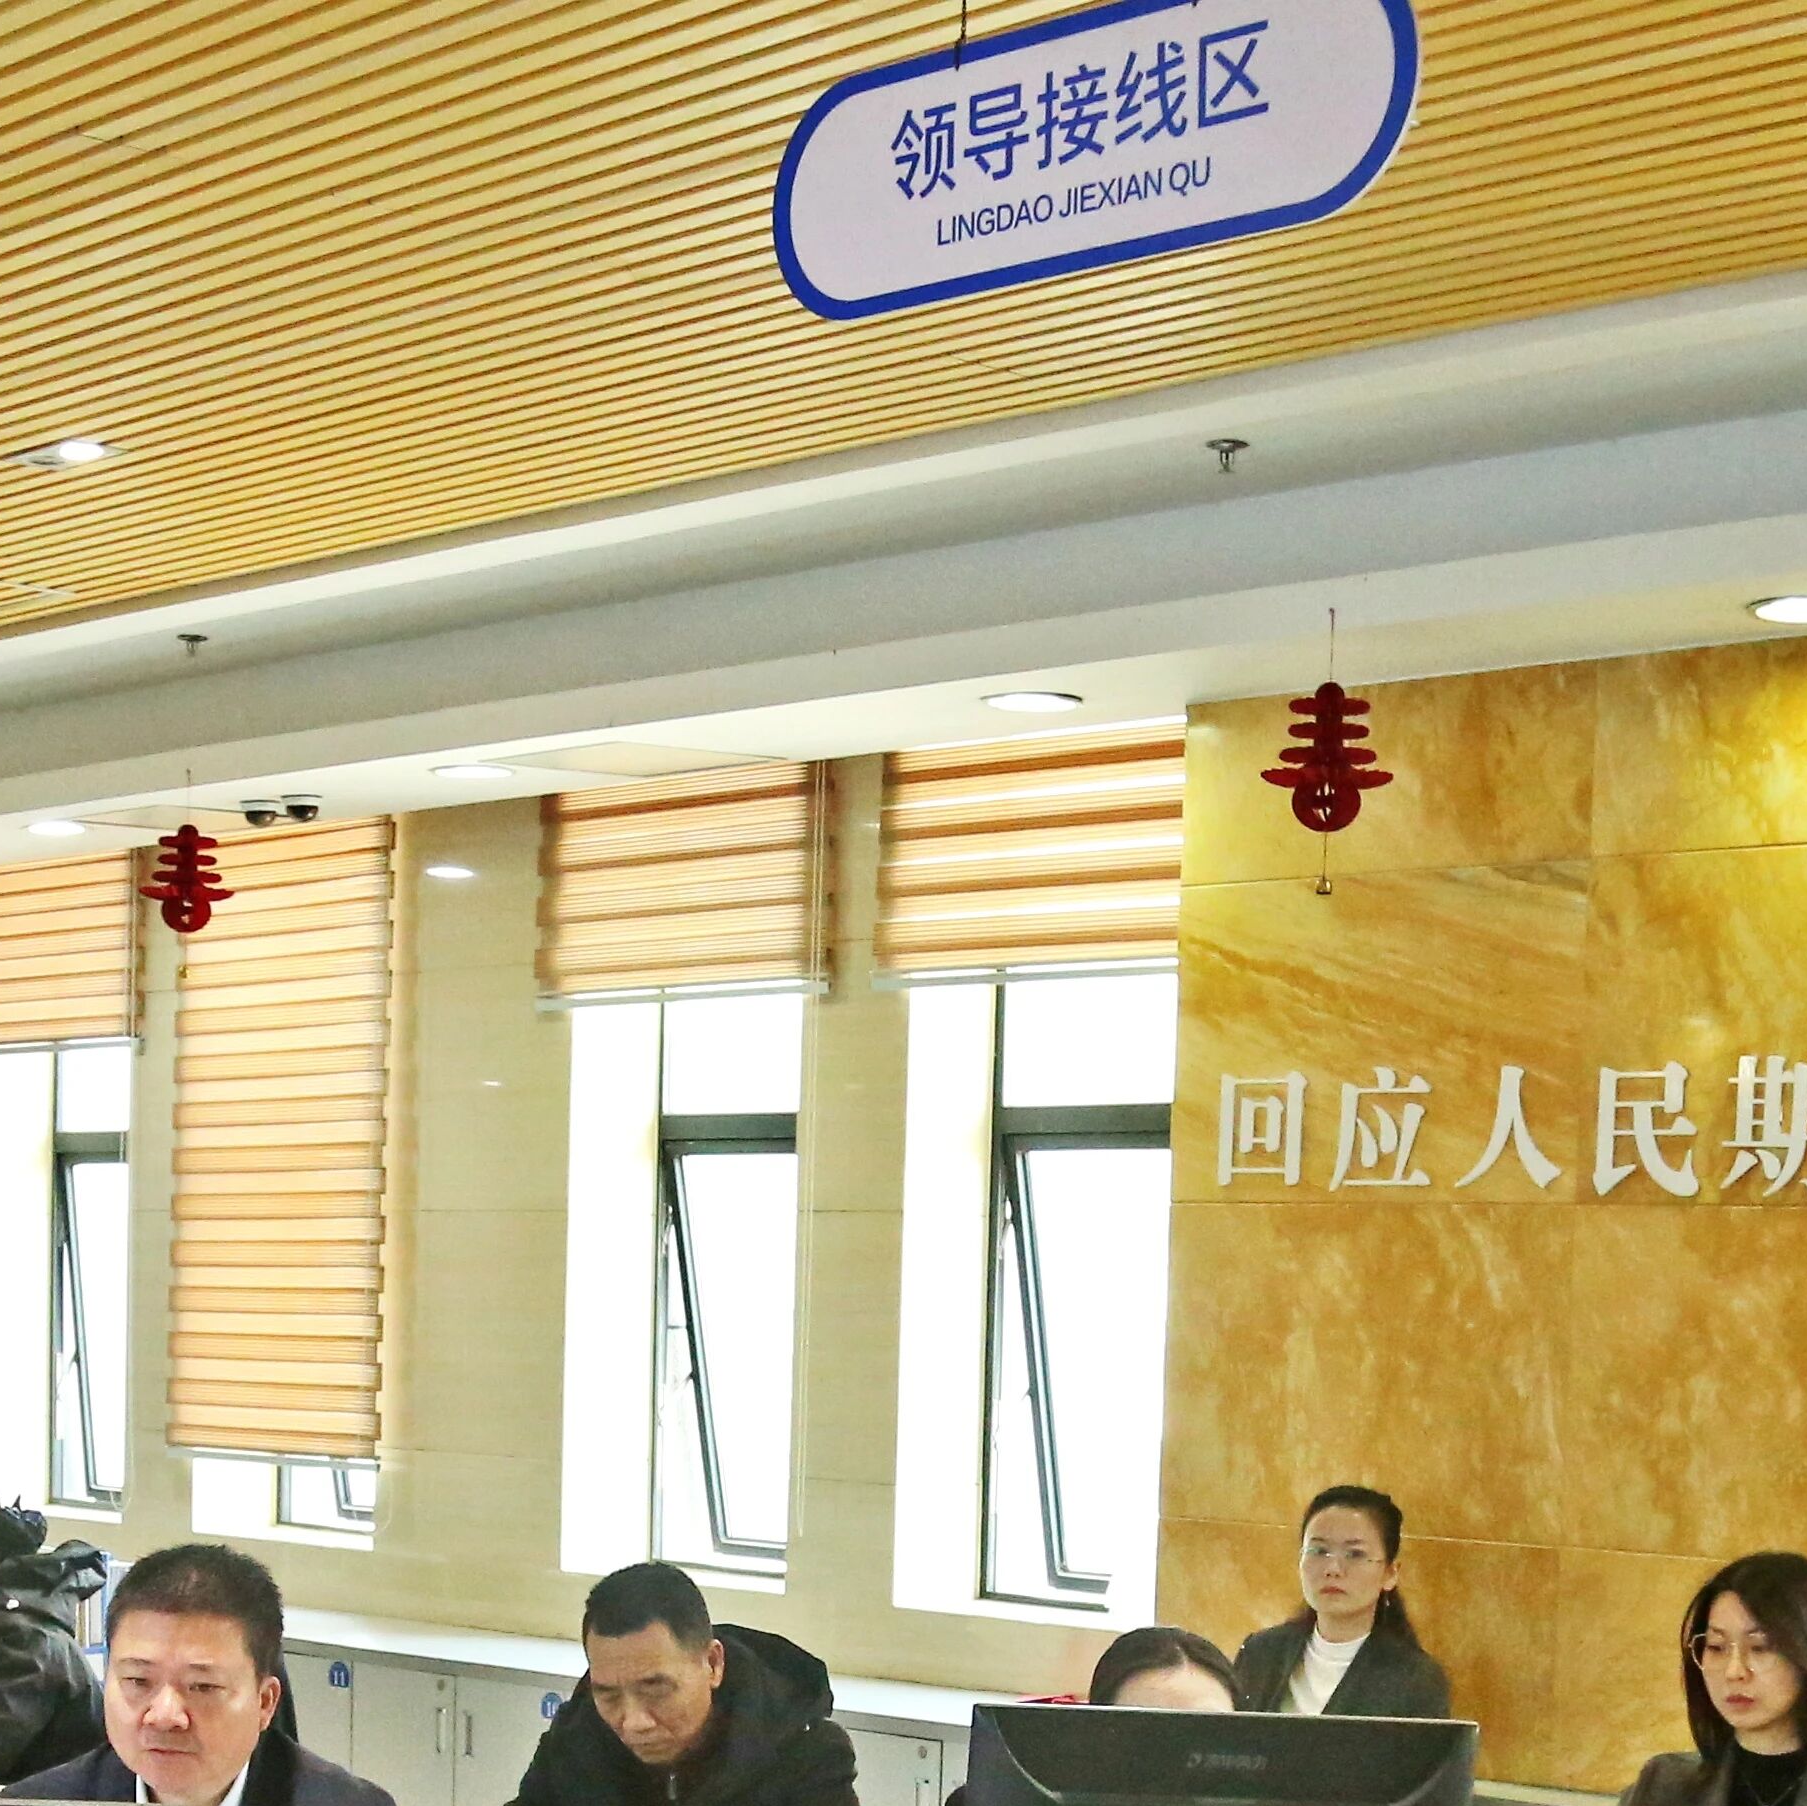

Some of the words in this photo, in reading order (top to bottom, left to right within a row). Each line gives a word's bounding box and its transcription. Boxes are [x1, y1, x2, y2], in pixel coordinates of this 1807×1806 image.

[891, 20, 1269, 200] 领导接线区
[937, 197, 1053, 246] LINGDAO
[1058, 167, 1163, 218] JIEXIAN
[1168, 157, 1211, 196] QU
